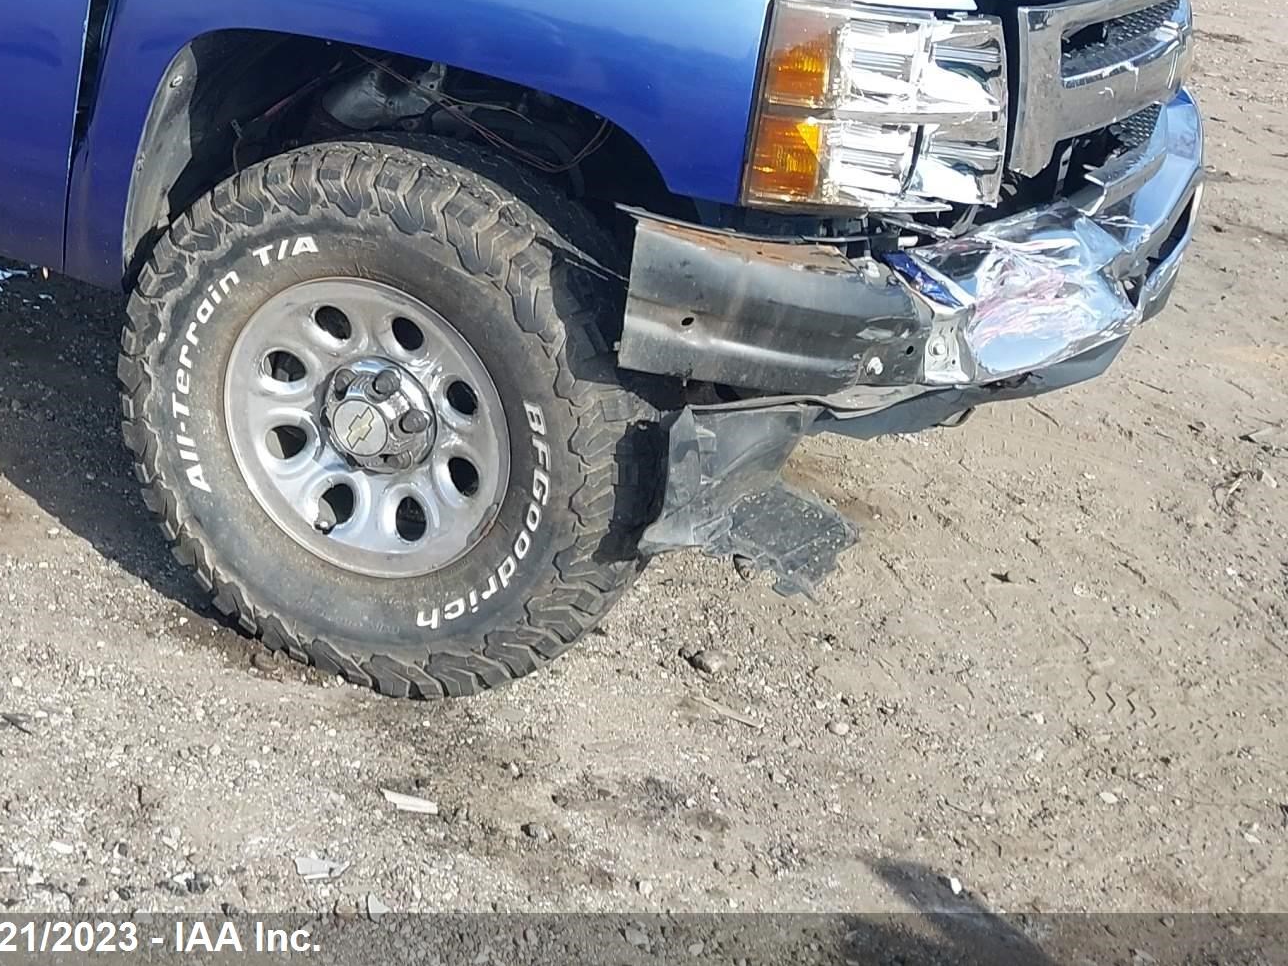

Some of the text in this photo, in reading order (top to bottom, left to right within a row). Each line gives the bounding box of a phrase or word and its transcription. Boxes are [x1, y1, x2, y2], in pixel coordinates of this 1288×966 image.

[171, 236, 319, 493] All-Terrain T/A
[416, 399, 553, 630] BFGoodrich
